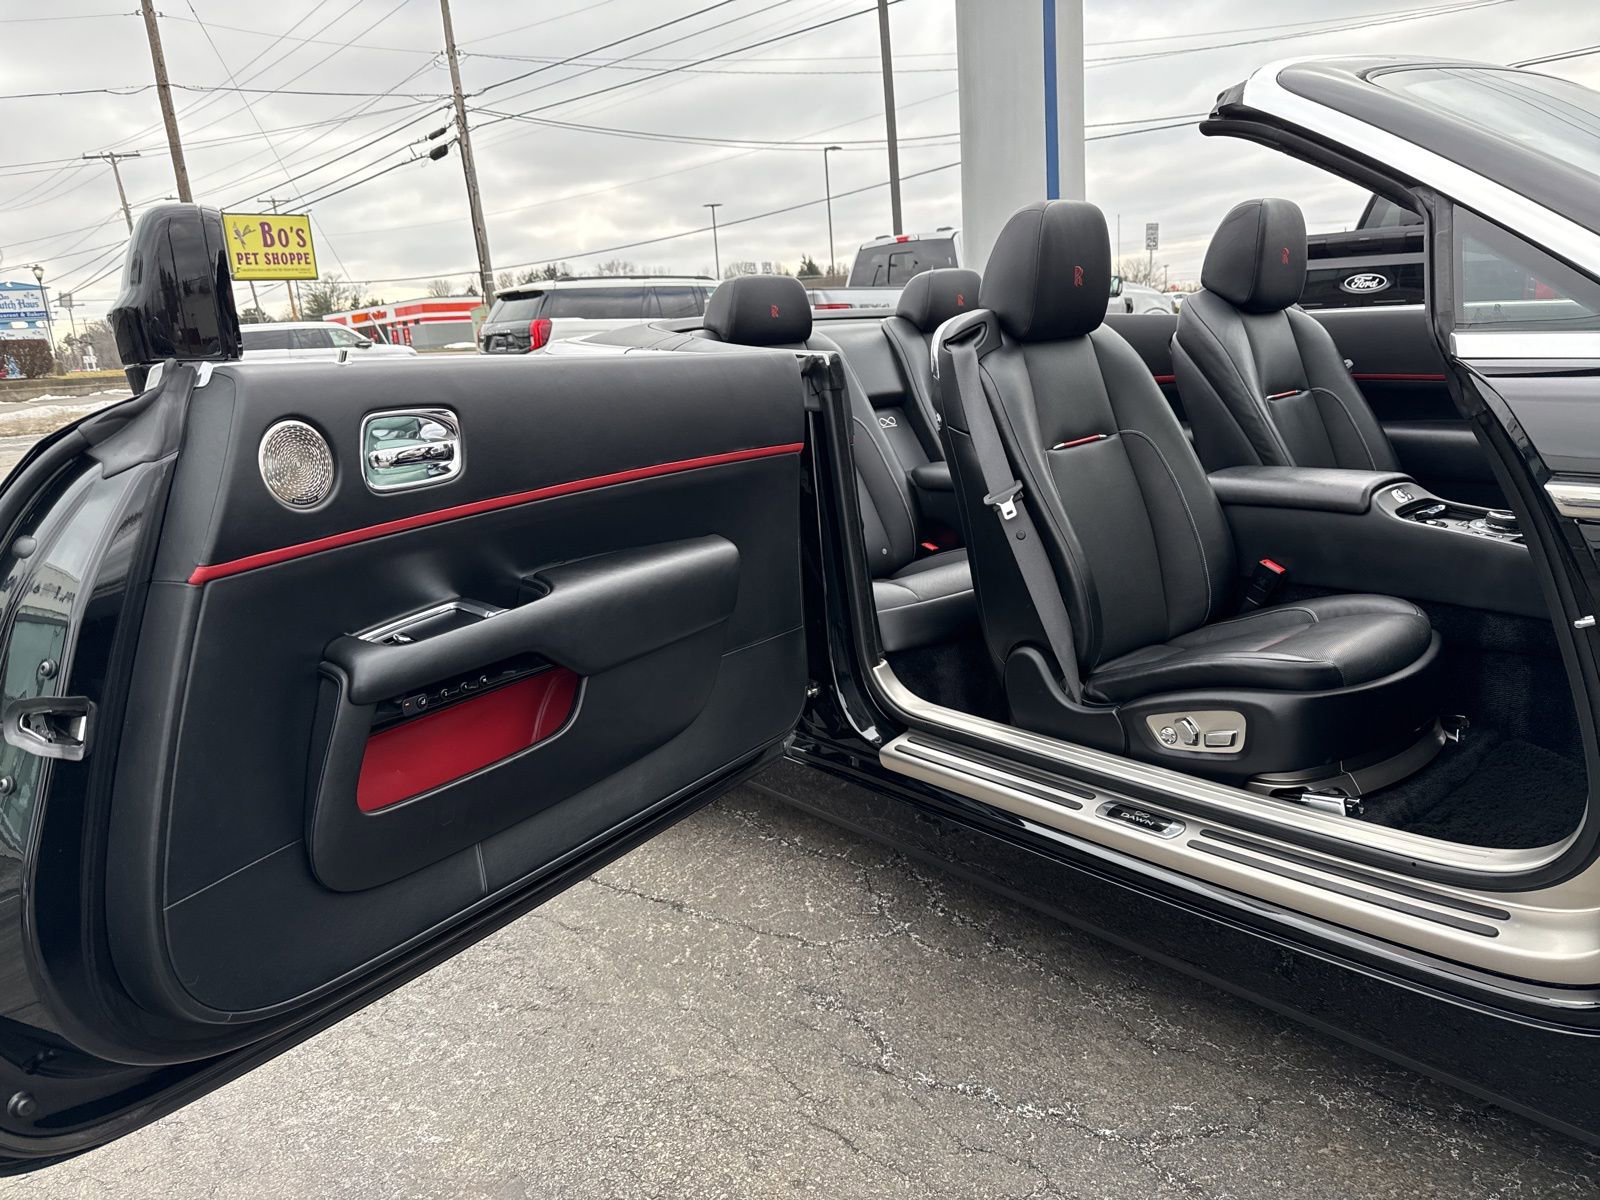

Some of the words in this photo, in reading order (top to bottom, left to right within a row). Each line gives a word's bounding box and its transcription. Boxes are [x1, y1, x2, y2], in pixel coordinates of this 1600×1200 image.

[236, 252, 259, 265] PET
[264, 252, 311, 265] SHOPPE
[1351, 276, 1379, 289] Ford
[0, 300, 16, 310] utch
[1121, 812, 1155, 826] DAWN
